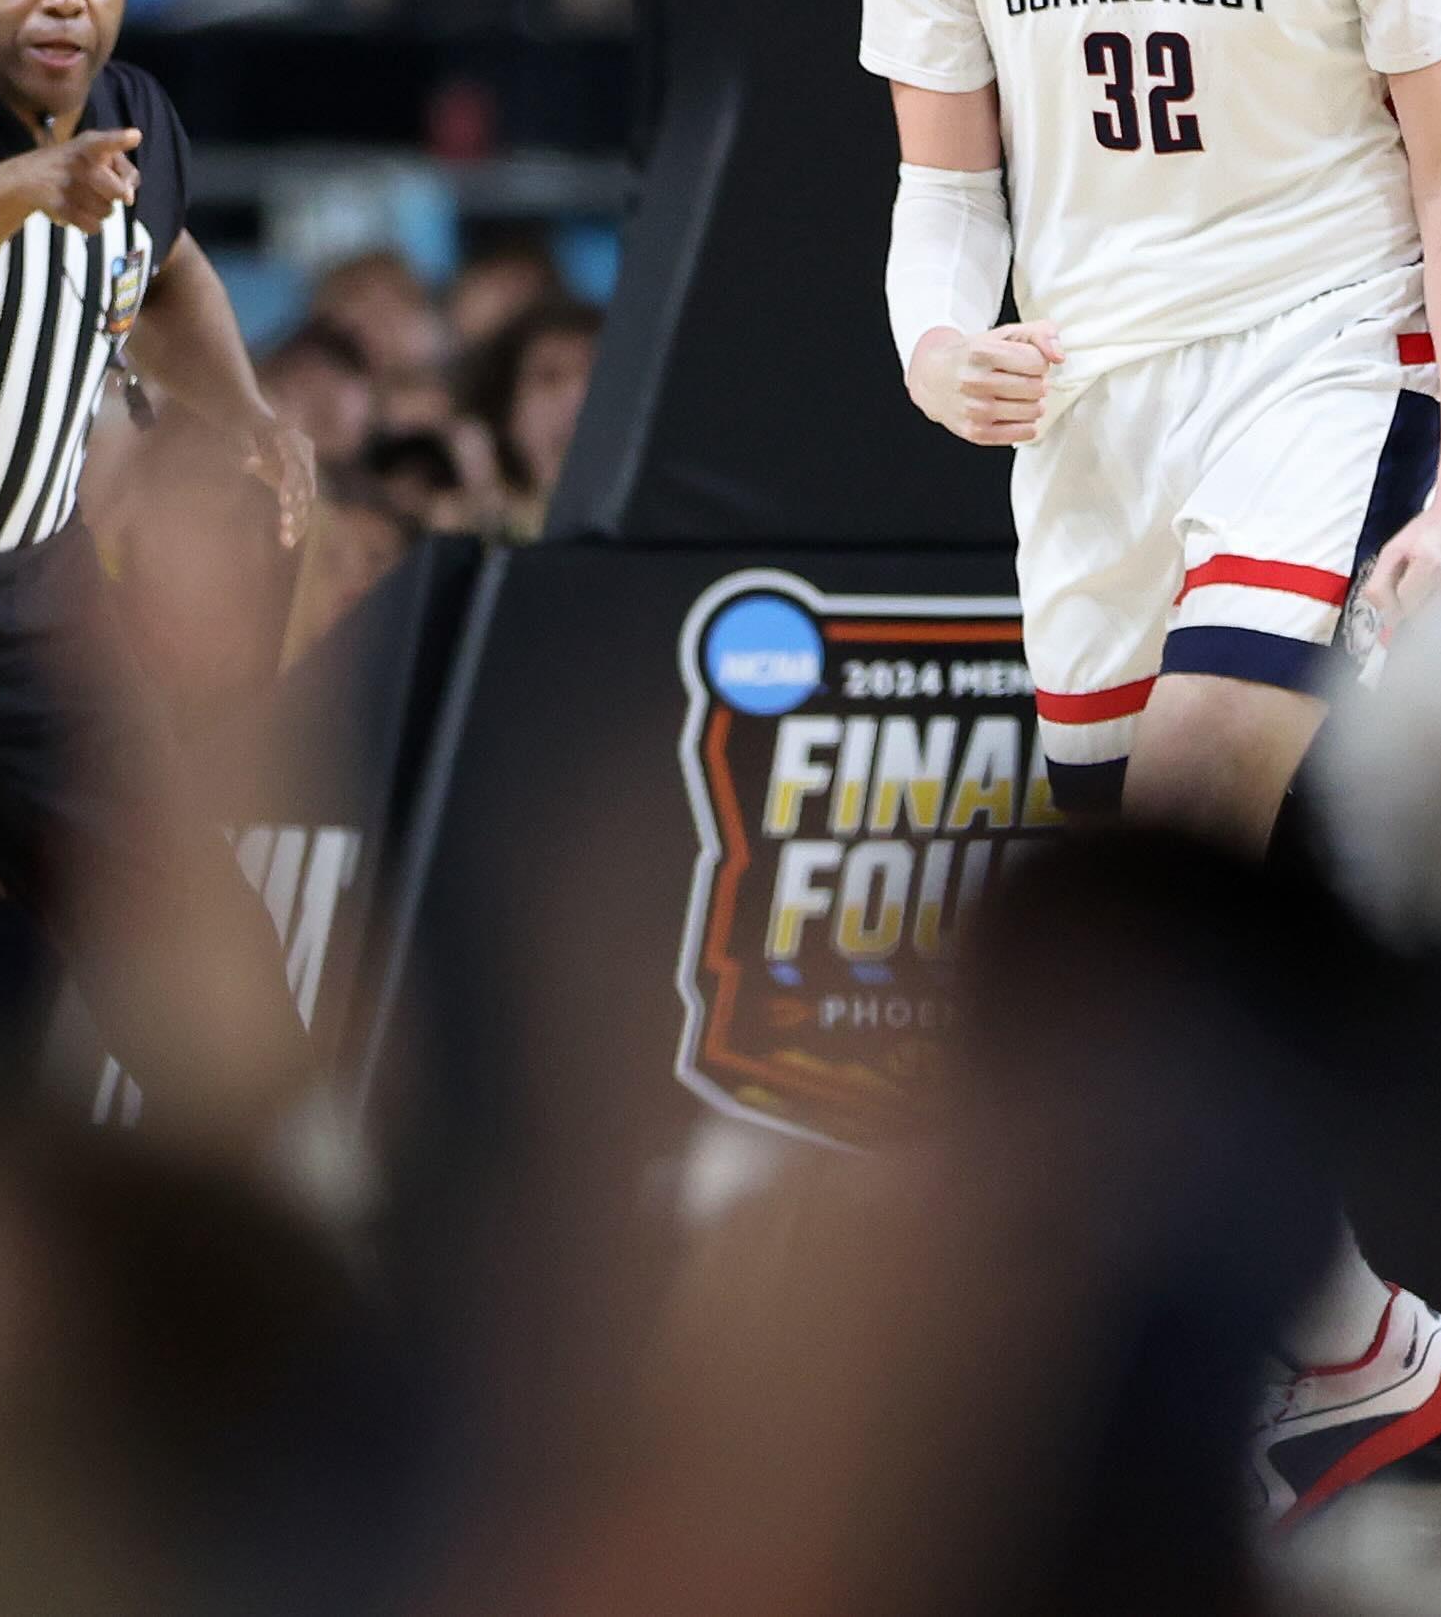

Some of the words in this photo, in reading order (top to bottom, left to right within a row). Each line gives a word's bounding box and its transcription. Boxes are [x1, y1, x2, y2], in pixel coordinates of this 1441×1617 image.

[1084, 31, 1205, 154] 32
[843, 659, 944, 698] 2024
[765, 840, 1040, 960] FOU
